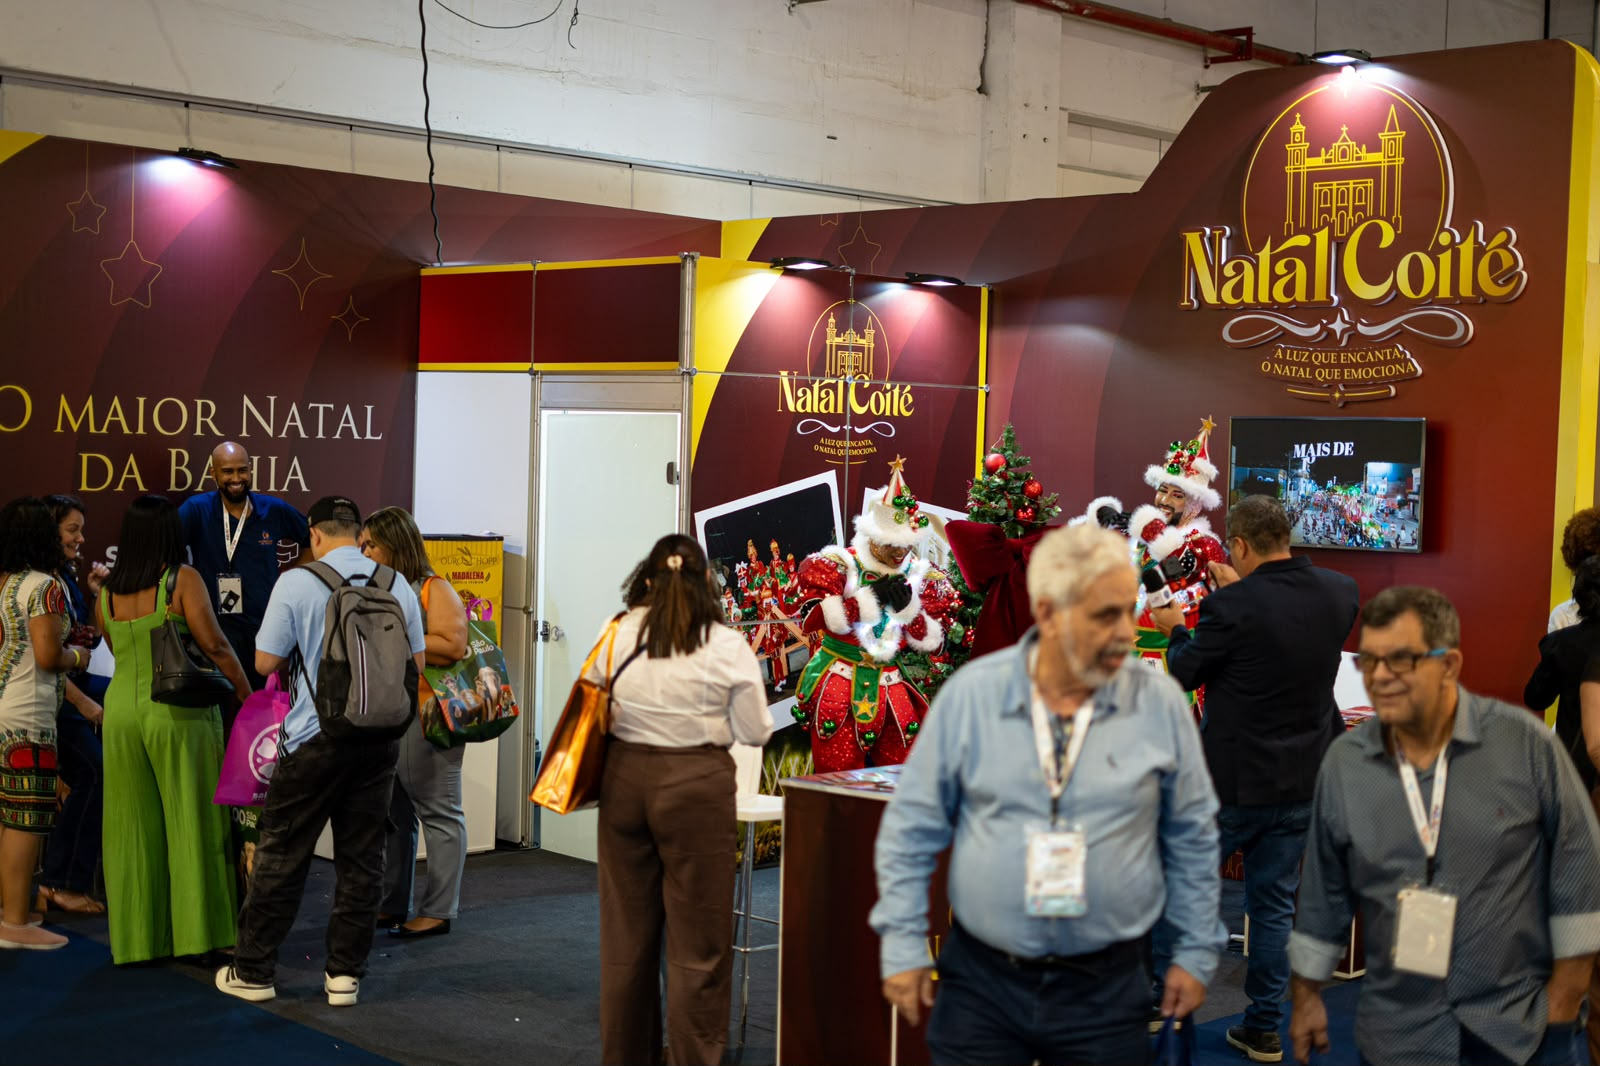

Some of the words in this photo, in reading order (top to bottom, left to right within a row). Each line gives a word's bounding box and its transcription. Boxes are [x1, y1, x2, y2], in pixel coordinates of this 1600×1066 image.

[1181, 226, 1330, 305] Natal
[1343, 219, 1519, 300] Coité
[1261, 361, 1271, 372] O
[1273, 363, 1312, 379] NATAL
[1315, 368, 1341, 382] QUE
[1344, 362, 1415, 380] EMOCIONA
[1274, 348, 1283, 359] A
[1286, 349, 1310, 363] LUZ
[1312, 351, 1338, 366] QUE
[1340, 348, 1405, 364] ENCANTA,
[0, 385, 32, 432] O
[53, 393, 225, 437] MAIOR
[238, 393, 383, 440] NATAL
[777, 370, 844, 414] Natal
[848, 373, 915, 417] Coité
[1293, 442, 1331, 459] MAIS
[1333, 441, 1354, 456] DE
[78, 452, 147, 492] DA
